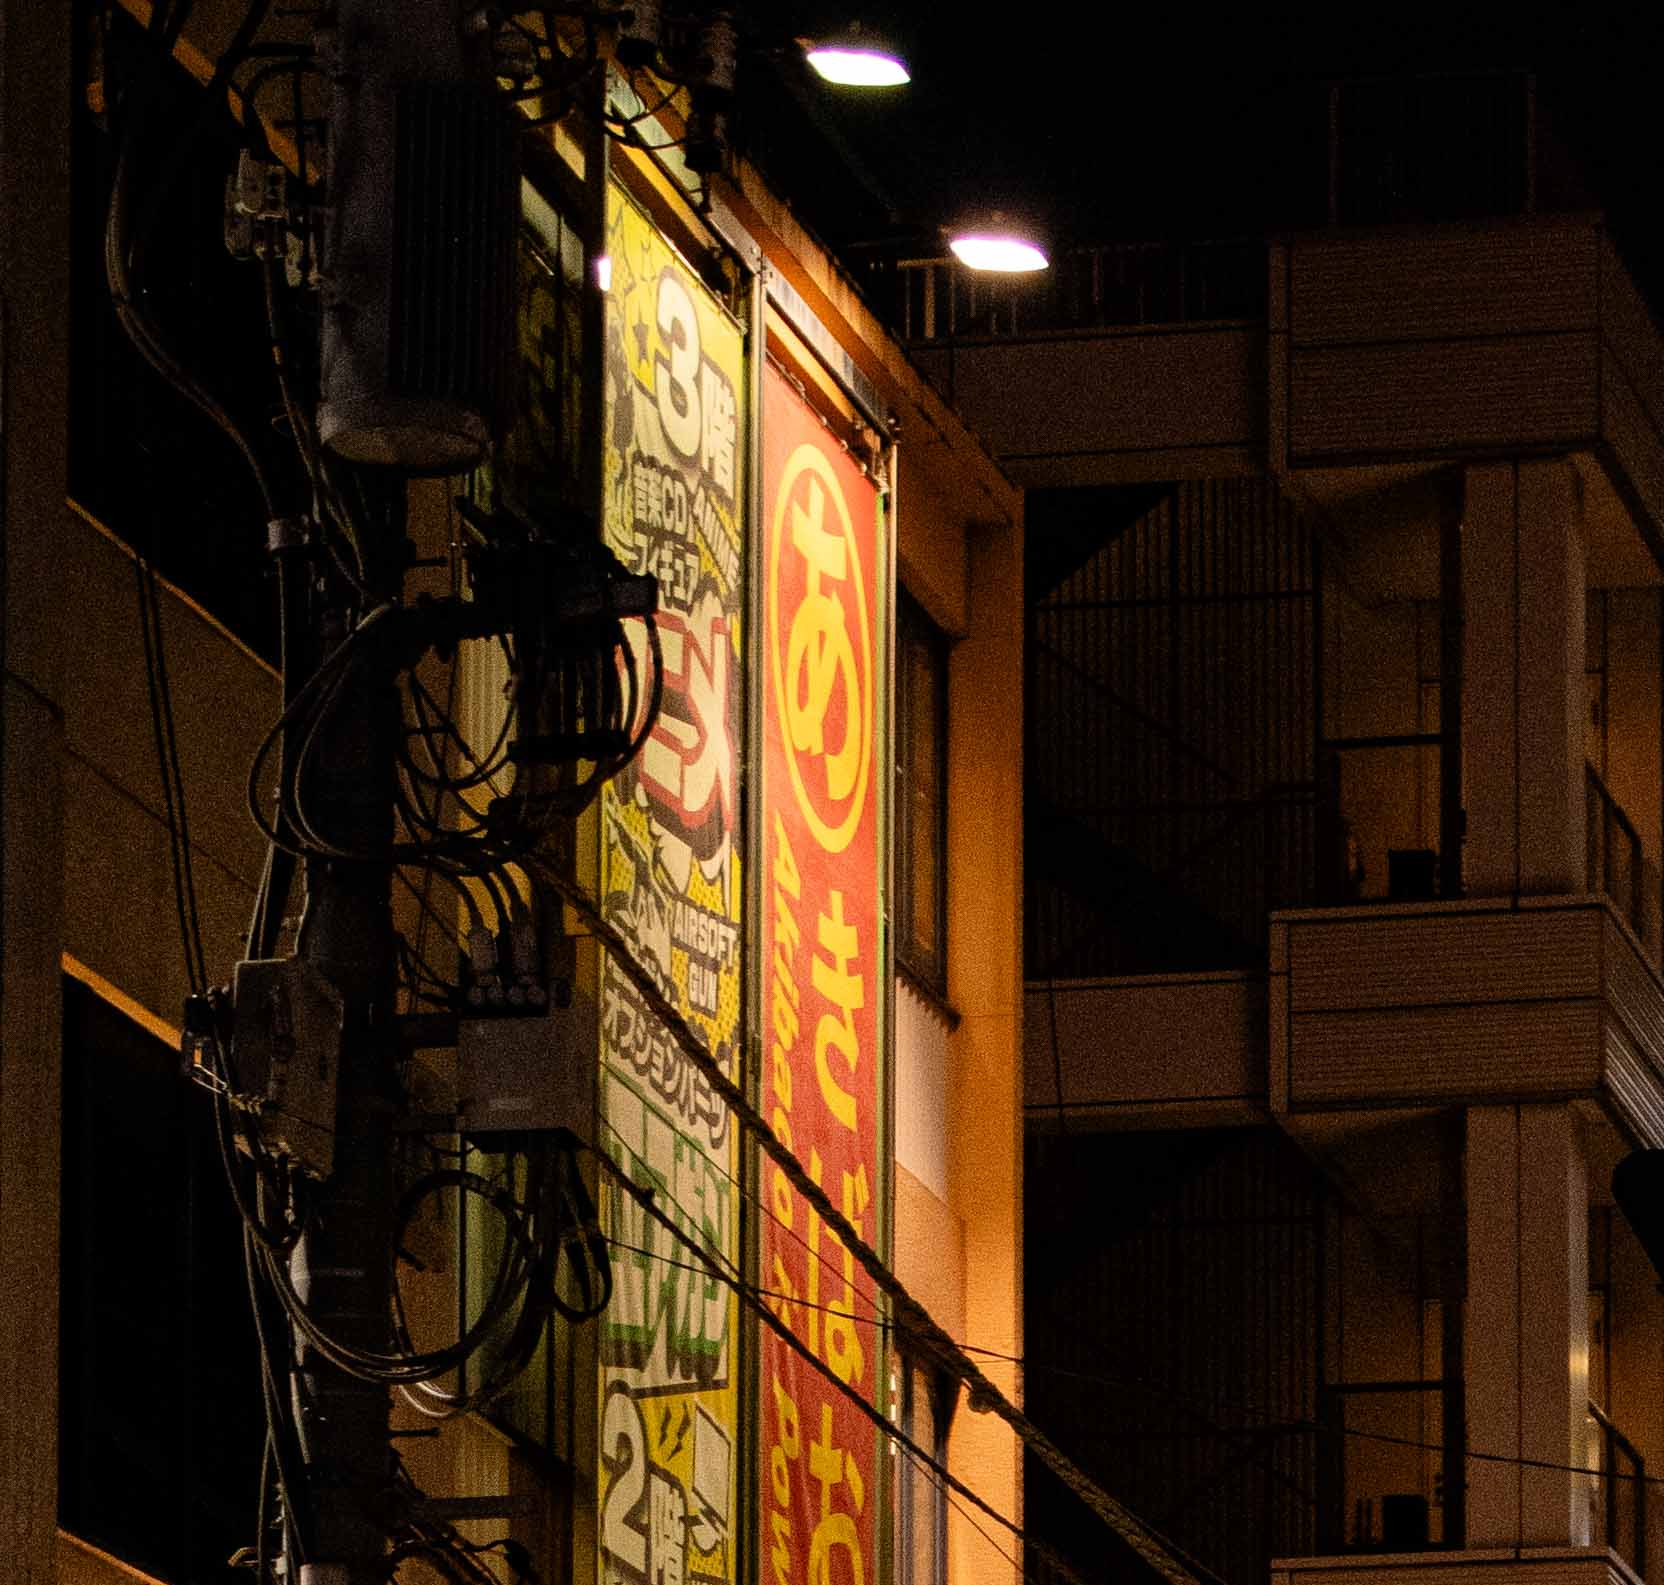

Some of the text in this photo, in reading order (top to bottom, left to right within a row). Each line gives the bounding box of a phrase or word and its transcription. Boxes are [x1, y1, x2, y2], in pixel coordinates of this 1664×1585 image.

[655, 280, 737, 510] 3階
[672, 900, 740, 975] AIRSOFT
[688, 958, 719, 1018] GUN
